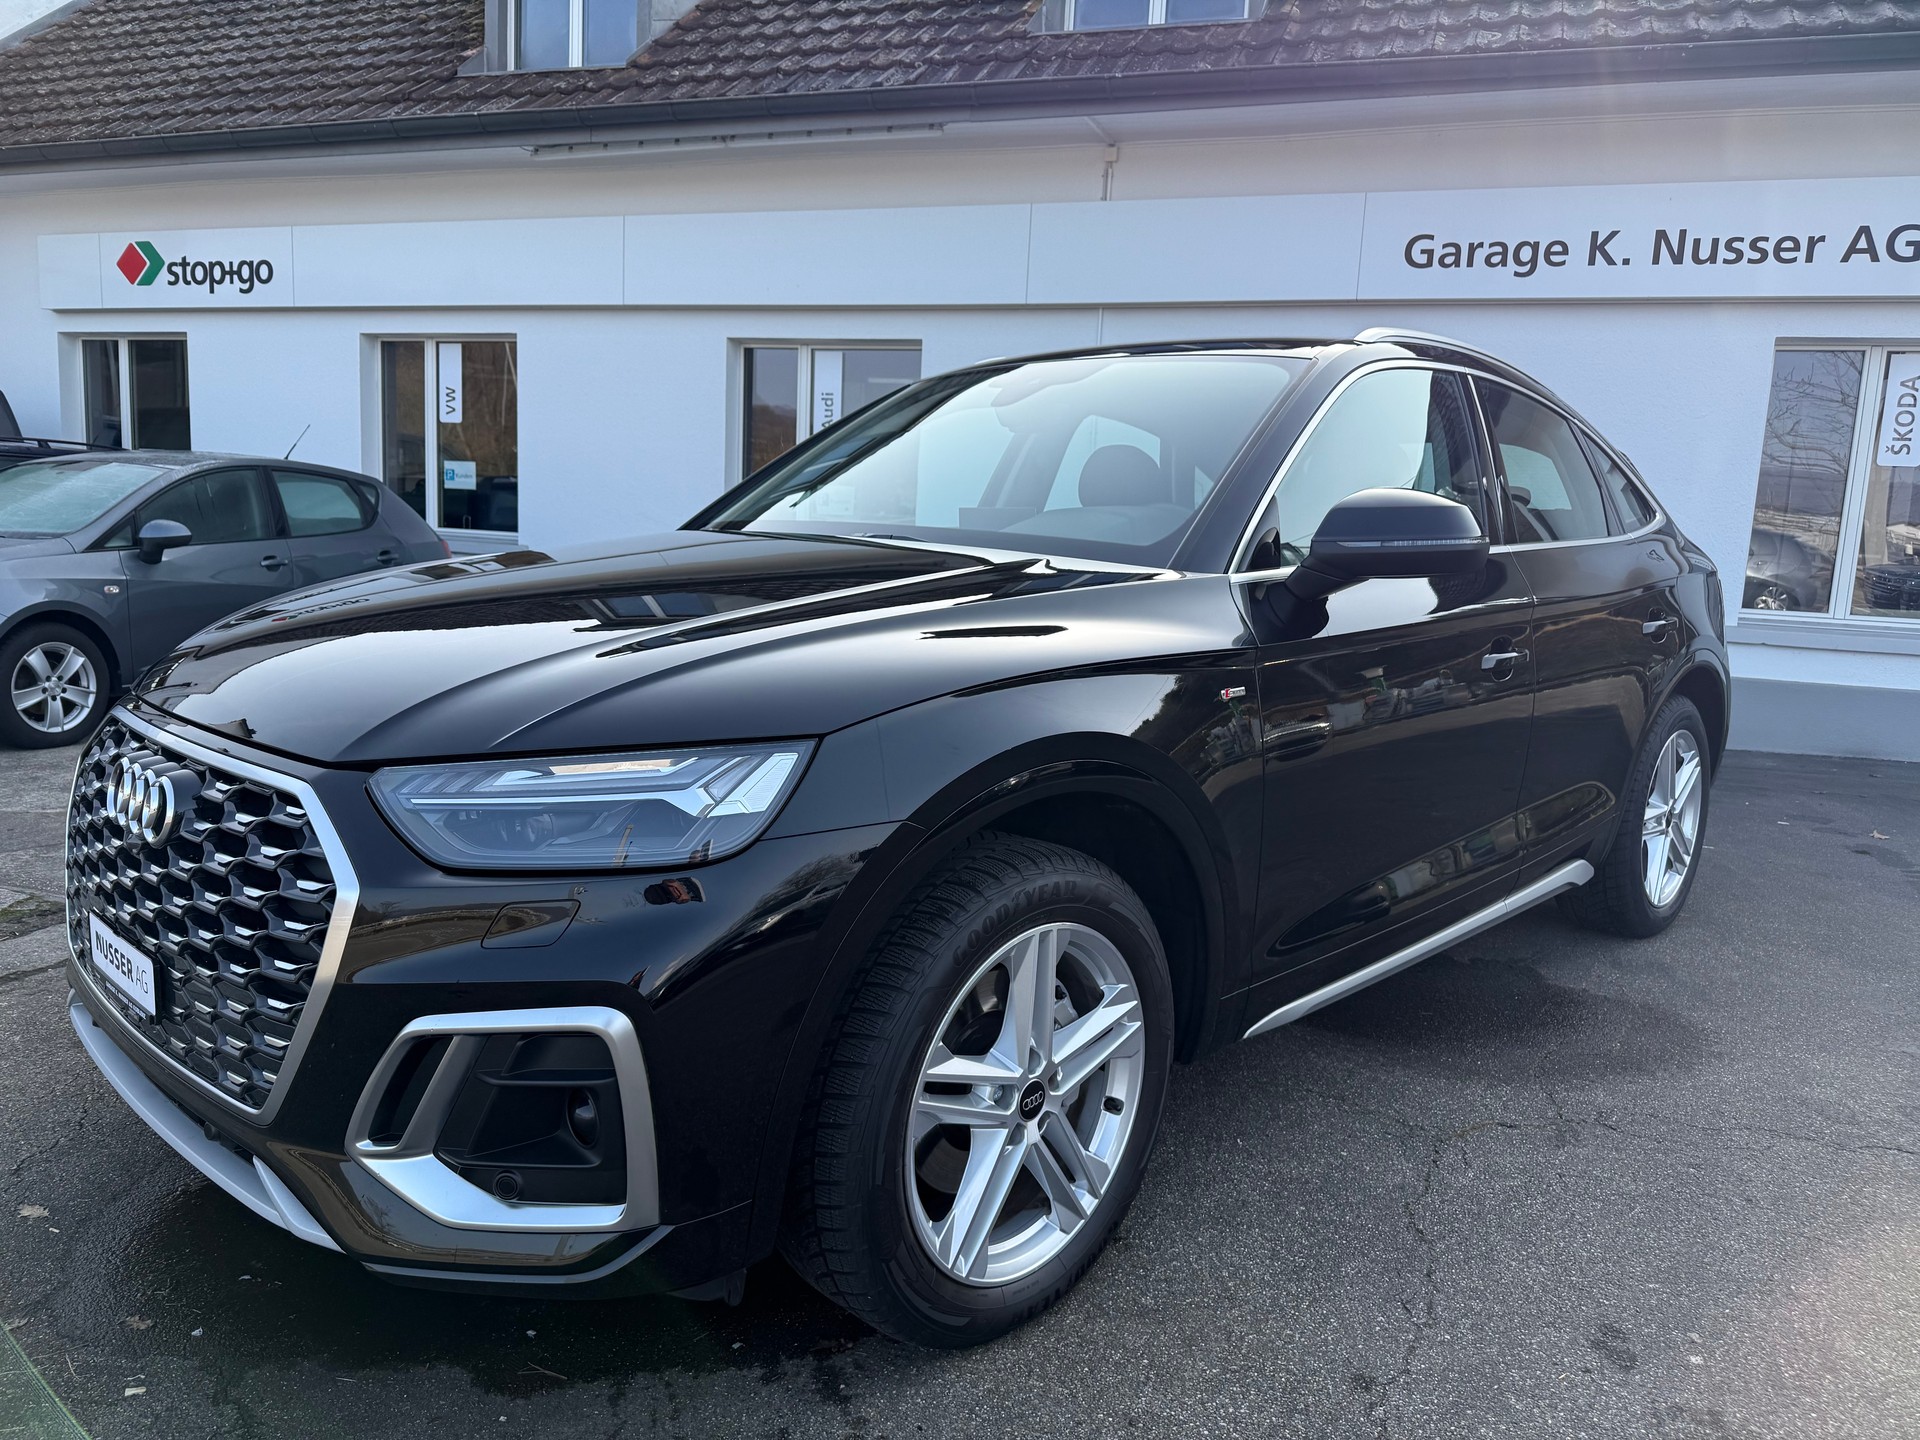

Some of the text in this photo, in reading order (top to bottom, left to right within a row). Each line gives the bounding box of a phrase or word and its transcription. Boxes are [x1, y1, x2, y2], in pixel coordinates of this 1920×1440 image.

[167, 255, 273, 294] stop+go
[1404, 224, 1920, 278] Garage K. Nusser AG
[445, 386, 456, 415] VW
[1885, 375, 1920, 455] ŠKODA
[952, 879, 1078, 968] GOODYEAR
[95, 930, 149, 994] NUSSER AG
